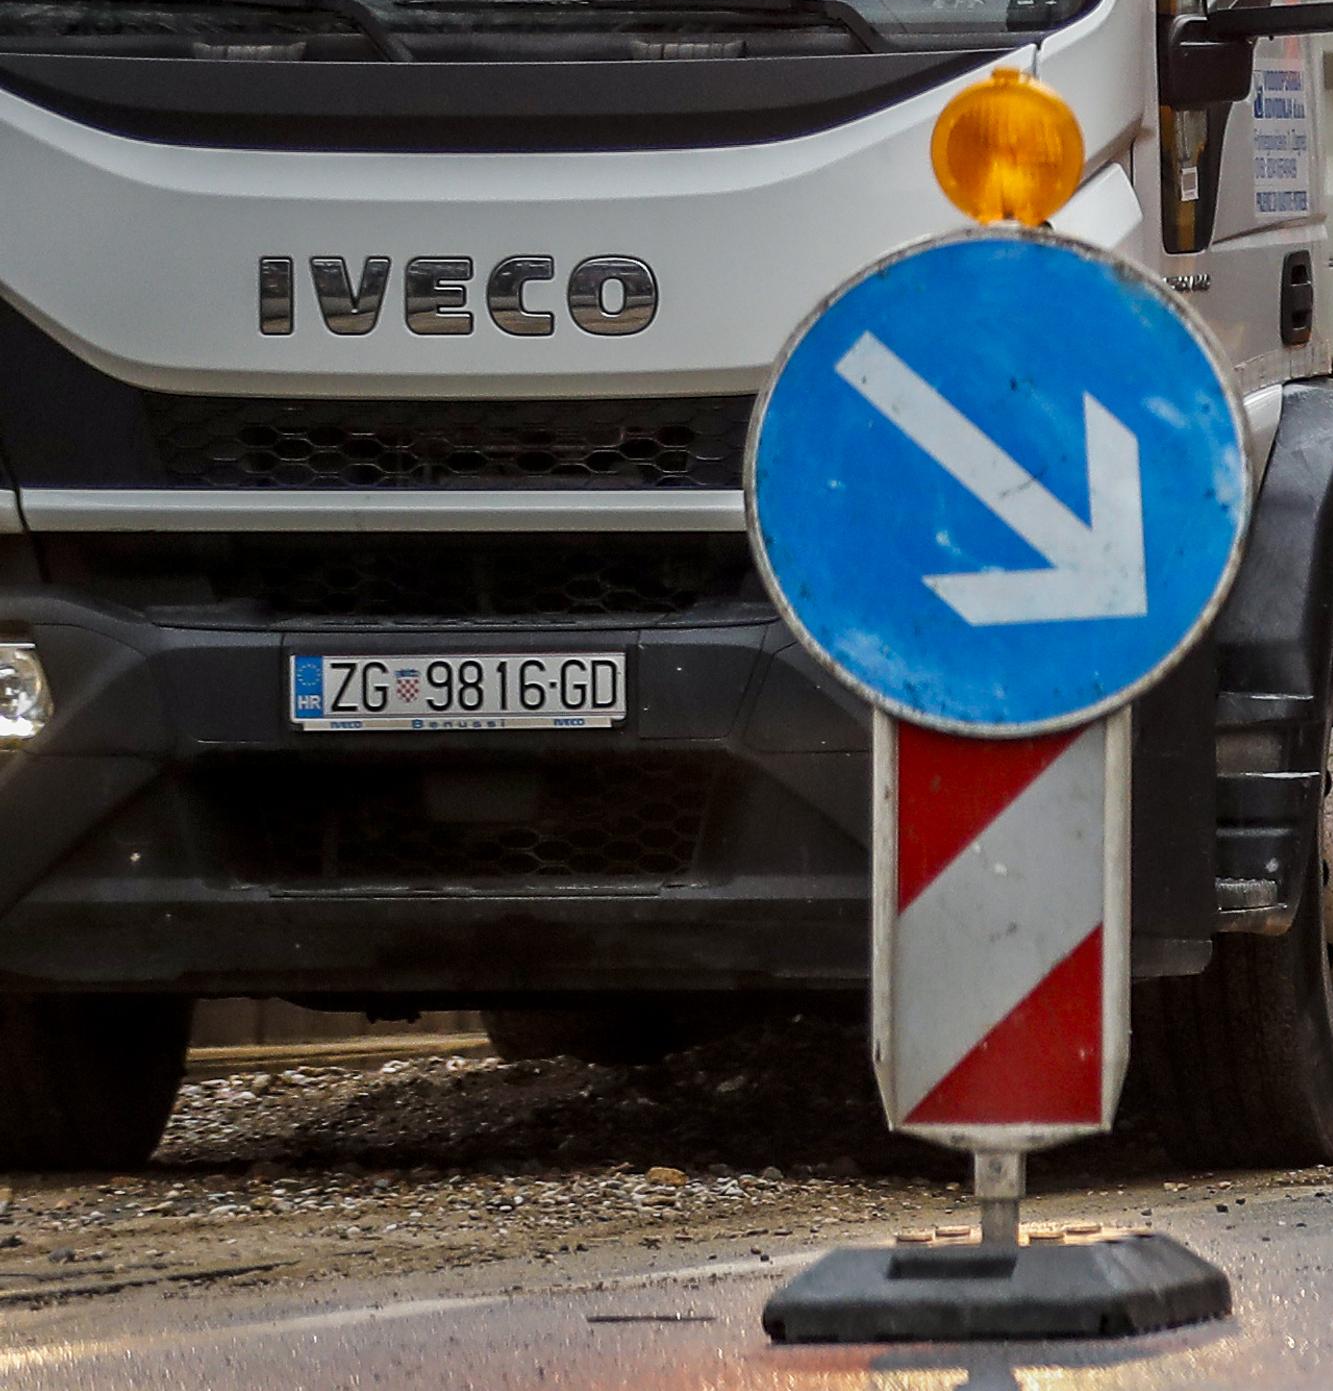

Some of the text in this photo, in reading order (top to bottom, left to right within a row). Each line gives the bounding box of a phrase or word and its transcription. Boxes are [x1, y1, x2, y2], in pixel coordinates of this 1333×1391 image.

[258, 254, 660, 337] IVECO
[297, 694, 322, 710] HR
[329, 661, 389, 713] ZG
[411, 718, 506, 729] Benussi
